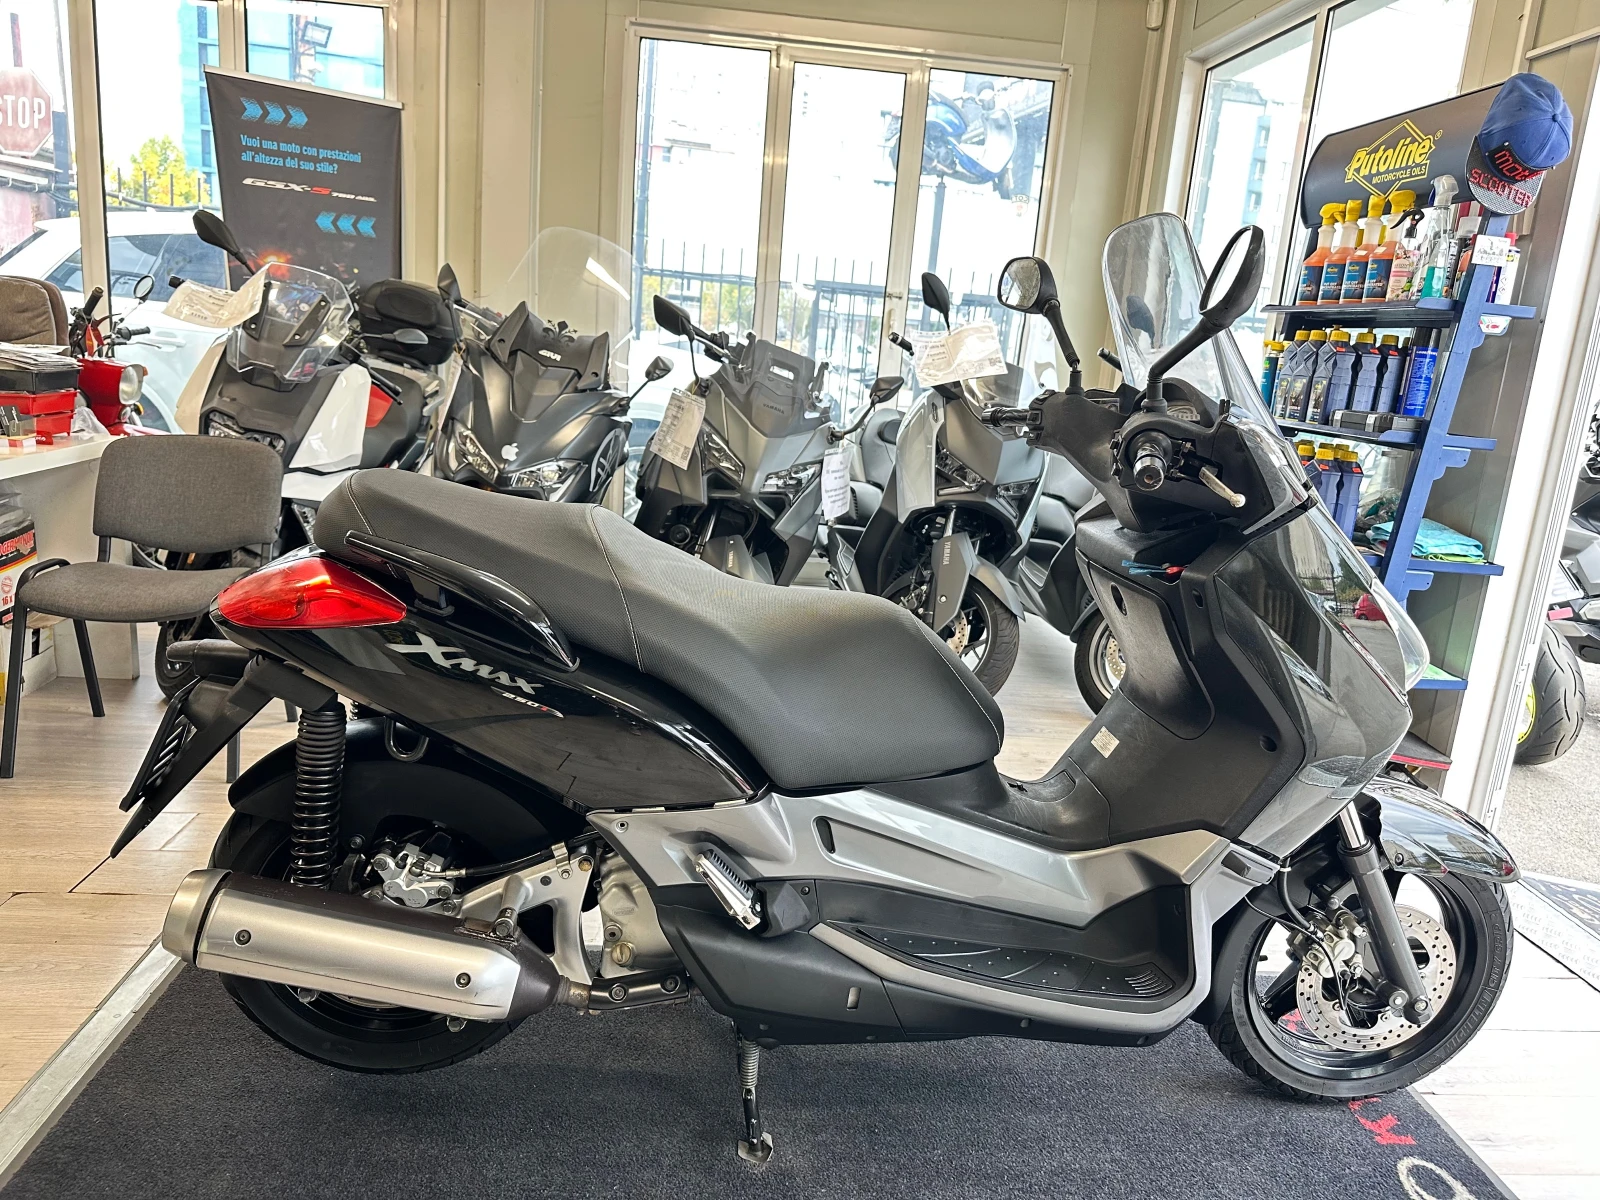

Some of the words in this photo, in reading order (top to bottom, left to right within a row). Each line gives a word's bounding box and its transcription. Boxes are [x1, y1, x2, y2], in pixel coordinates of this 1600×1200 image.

[0, 94, 46, 130] TOP
[240, 134, 260, 148] Vuoi
[262, 139, 277, 151] una
[280, 142, 300, 154] moto
[302, 145, 317, 156] con
[319, 149, 361, 163] prestazioni
[241, 151, 283, 166] all'altezza
[285, 157, 298, 169] del
[300, 162, 314, 171] suo
[316, 162, 338, 174] stile?
[1347, 137, 1431, 179] Putoline
[1372, 169, 1411, 184] MOTORCYCLE
[1412, 165, 1426, 176] OILS
[1469, 168, 1533, 208] SCOOTER
[763, 403, 785, 415] YAMAHA
[942, 541, 951, 565] YAMAHA
[1444, 987, 1494, 1056] MICHELIN
